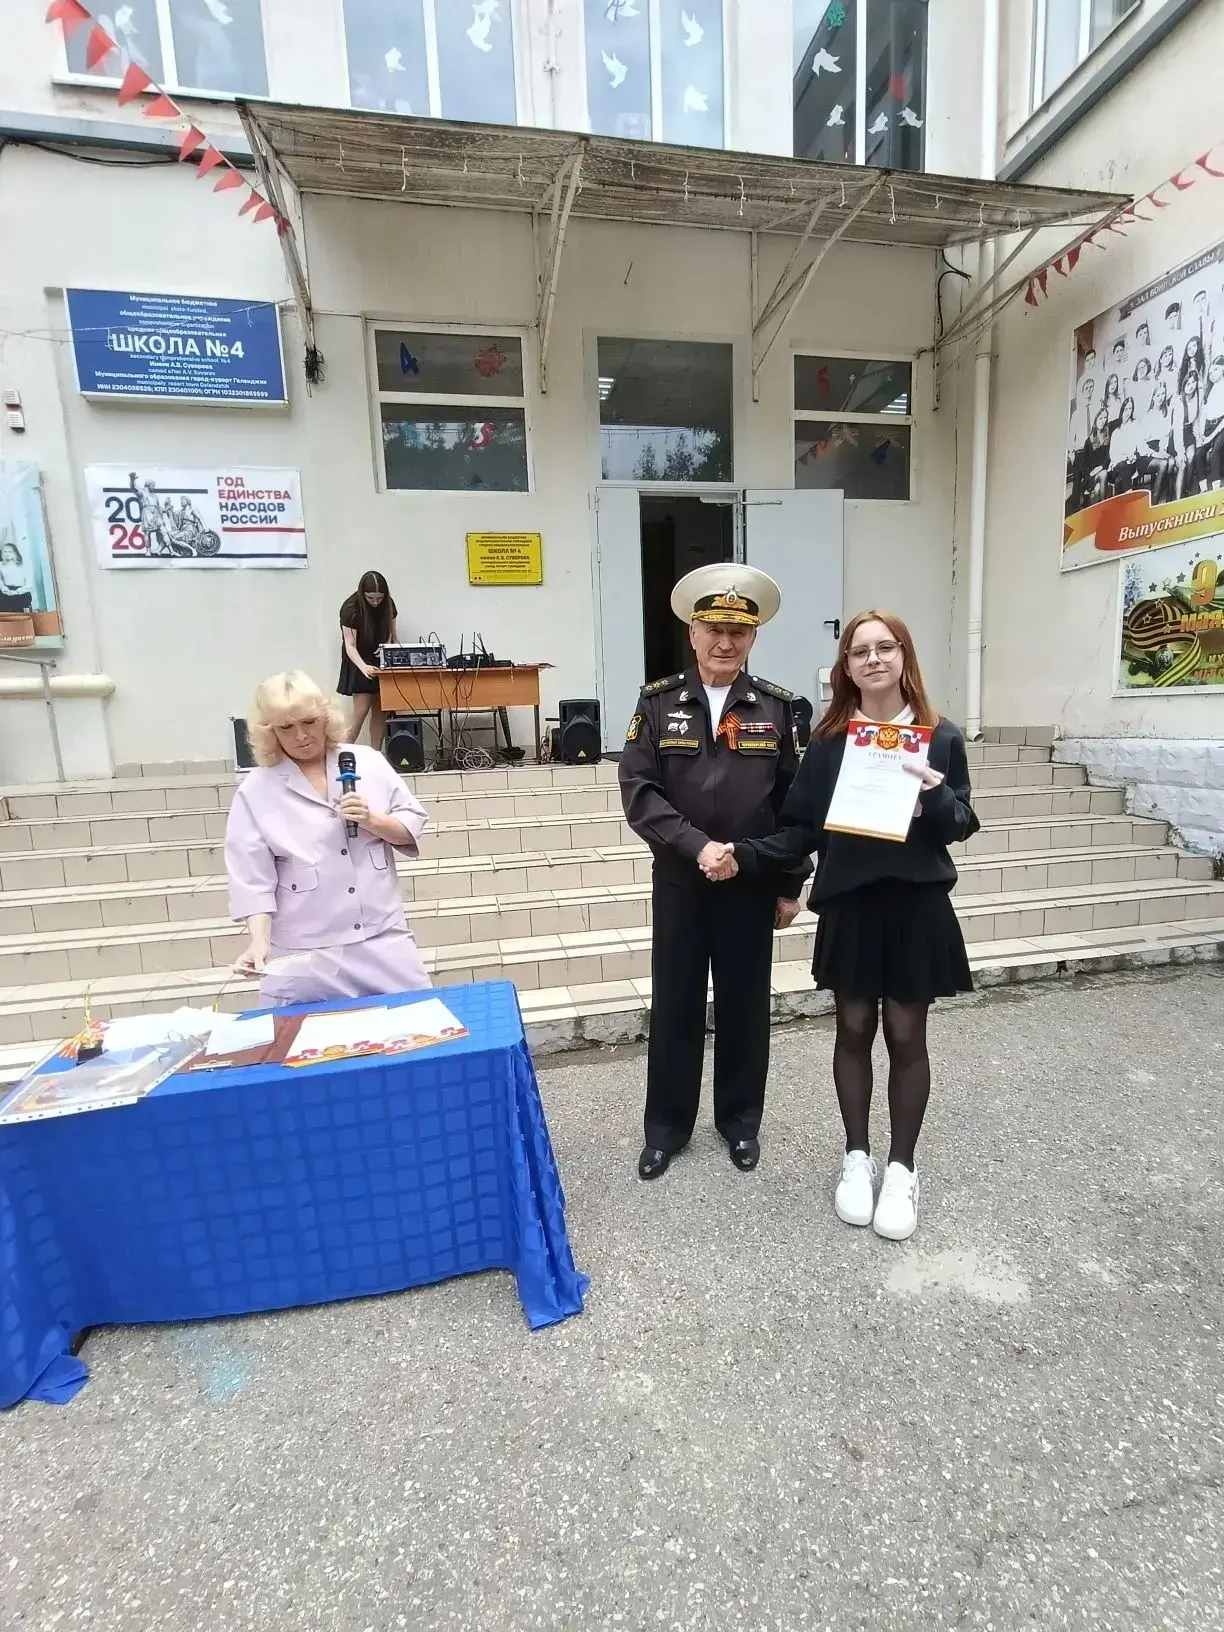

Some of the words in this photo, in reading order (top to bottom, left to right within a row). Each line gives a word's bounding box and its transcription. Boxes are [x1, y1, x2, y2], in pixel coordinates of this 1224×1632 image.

[129, 295, 180, 304] Муниципальное
[181, 299, 218, 307] бюджетное
[119, 310, 192, 320] общеобразовательное
[112, 333, 201, 356] ШКОЛА
[183, 362, 213, 370] Суворова
[94, 370, 149, 379] Муниципального
[216, 476, 245, 488] ГОД
[218, 489, 292, 501] ЕДИНСТВА
[105, 496, 143, 523] 20
[219, 502, 286, 513] НАРОДОВ
[220, 514, 278, 525] РОССИИ
[1117, 505, 1216, 542] Выпускники
[109, 523, 146, 550] 26
[1191, 560, 1217, 605] 9
